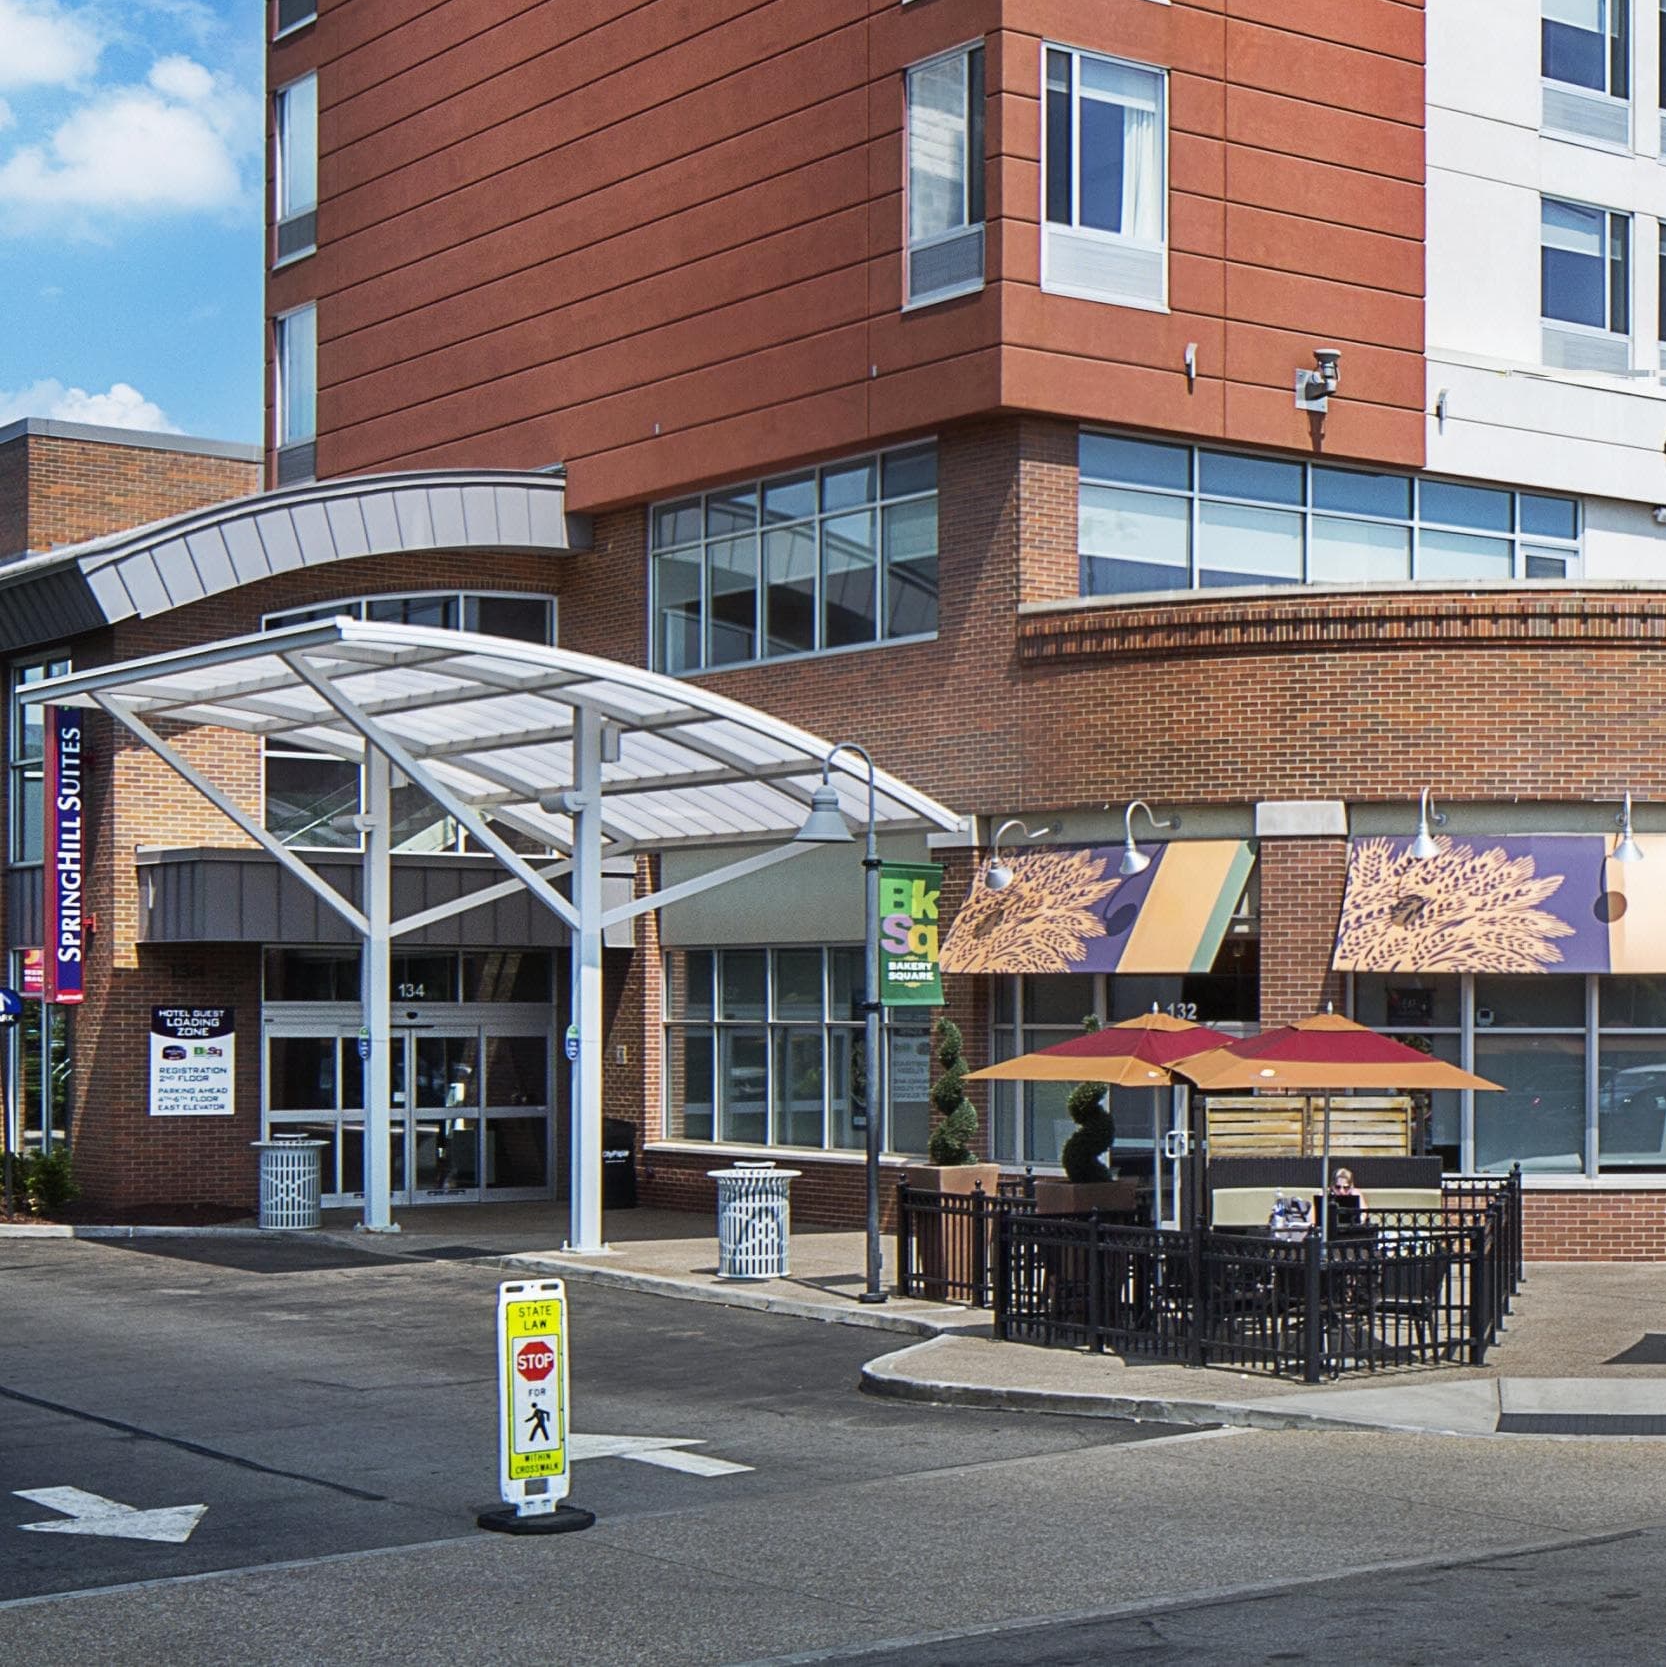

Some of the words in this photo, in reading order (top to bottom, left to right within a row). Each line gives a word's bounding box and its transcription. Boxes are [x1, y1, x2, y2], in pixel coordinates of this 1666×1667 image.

[57, 727, 81, 811] SUITES
[57, 815, 81, 963] SPRINGHILL
[880, 878, 940, 919] Bk
[881, 913, 939, 962] Sq
[888, 961, 933, 971] BAKERY
[888, 972, 935, 981] SQUARE
[398, 983, 426, 998] 134
[1167, 1003, 1198, 1020] 132
[166, 1018, 220, 1027] LOADING
[177, 1027, 209, 1036] ZONE
[518, 1305, 552, 1318] STATE
[523, 1319, 547, 1331] LAW
[517, 1352, 554, 1370] STOP
[528, 1387, 546, 1397] FOR
[524, 1453, 552, 1462] WITHIN
[515, 1463, 559, 1475] CROSSWALK
